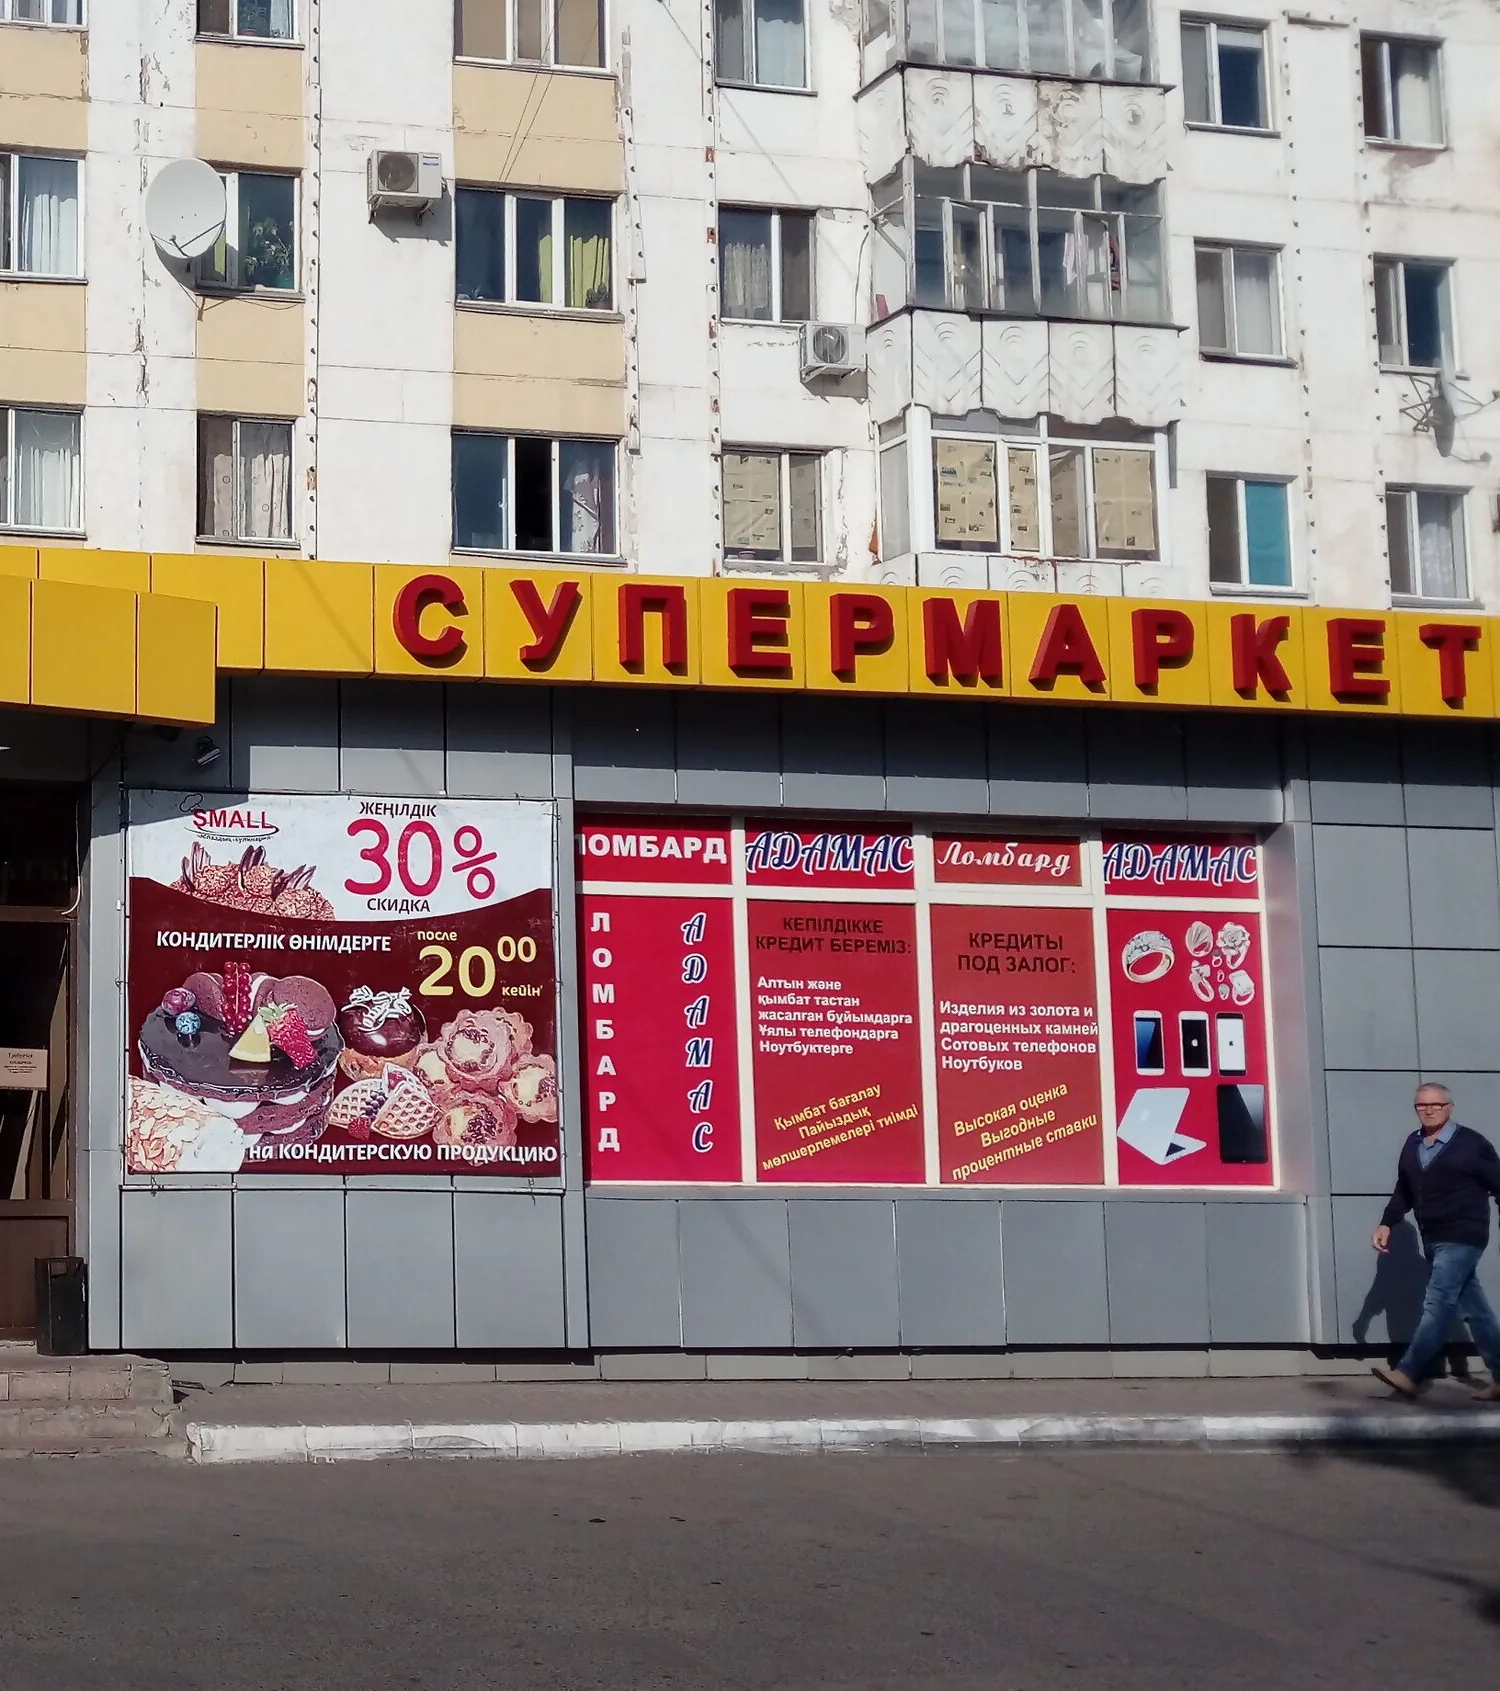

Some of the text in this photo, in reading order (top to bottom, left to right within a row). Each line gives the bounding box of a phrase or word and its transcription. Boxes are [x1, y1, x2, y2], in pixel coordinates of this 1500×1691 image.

[394, 574, 1482, 708] СУПЕРМАРКЕТ
[192, 808, 275, 829] SMALL
[359, 802, 437, 819] ЖЕҢІЛДІК
[345, 818, 498, 900] 30%
[937, 841, 1071, 877] Ломбард
[367, 898, 431, 914] СКИДКА
[783, 917, 884, 934] КЕПІЛДІККЕ
[156, 930, 392, 953] КОНДИТЕРЛІК ӨНІМДЕРГЕ
[417, 931, 458, 941] после
[756, 936, 912, 954] КРЕДИТ БЕРЕМІЗ:
[969, 932, 1063, 951] КРЕДИТЫ
[958, 954, 1076, 974] ПОД ЗАЛОГ:
[757, 976, 842, 990] Алтын және
[758, 993, 860, 1006] қымбат тастан
[940, 1000, 1093, 1017] Изделия из золота и
[590, 912, 621, 1152] ЛОМБАРД
[940, 1021, 1099, 1036] драгоценных камней
[759, 1040, 854, 1056] Ноутбуктерге
[941, 1037, 1097, 1055] Сотовых телефонов
[942, 1056, 1023, 1073] Ноутбуков
[774, 1084, 882, 1131] Қымбат бағалау
[877, 1104, 919, 1129] тиімді
[954, 1084, 1069, 1137] Высокая оценка
[980, 1110, 1056, 1148] Выгодные
[249, 1143, 558, 1165] на КОНДИТЕРСКУЮ ПРОДУКЦИЮ
[952, 1114, 1098, 1181] процентные ставки
